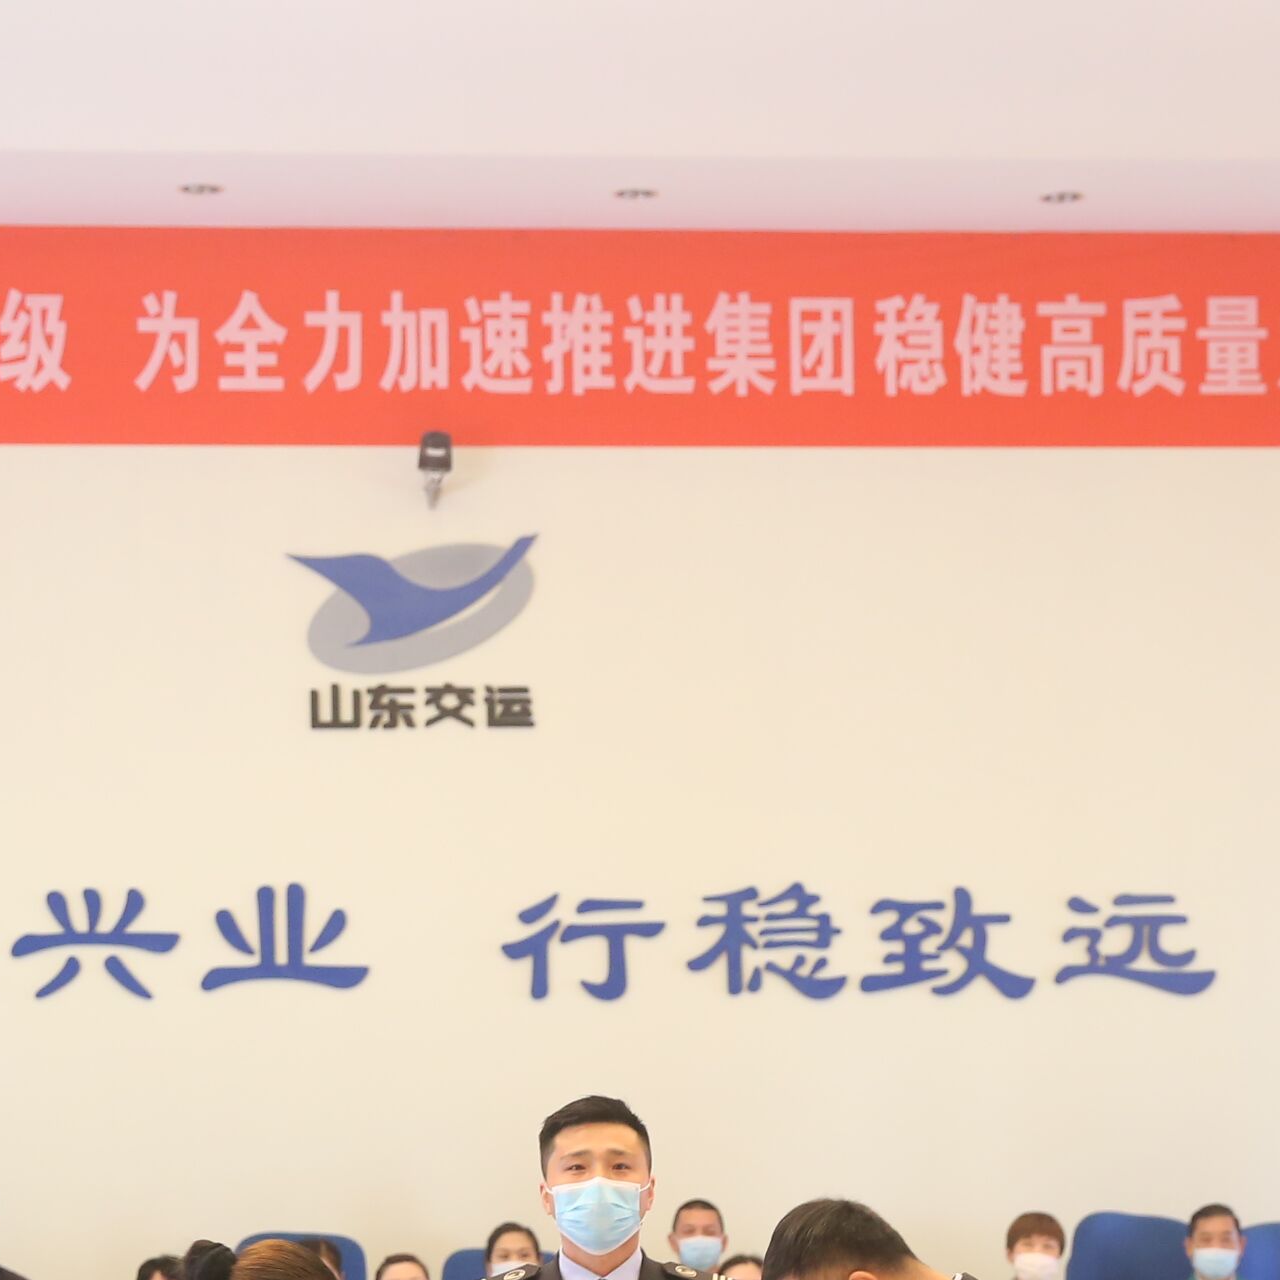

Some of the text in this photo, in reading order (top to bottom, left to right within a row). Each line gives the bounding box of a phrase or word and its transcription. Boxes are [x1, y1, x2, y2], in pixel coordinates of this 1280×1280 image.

[309, 683, 535, 730] 山东交运
[501, 882, 1216, 1001] 行稳致远
